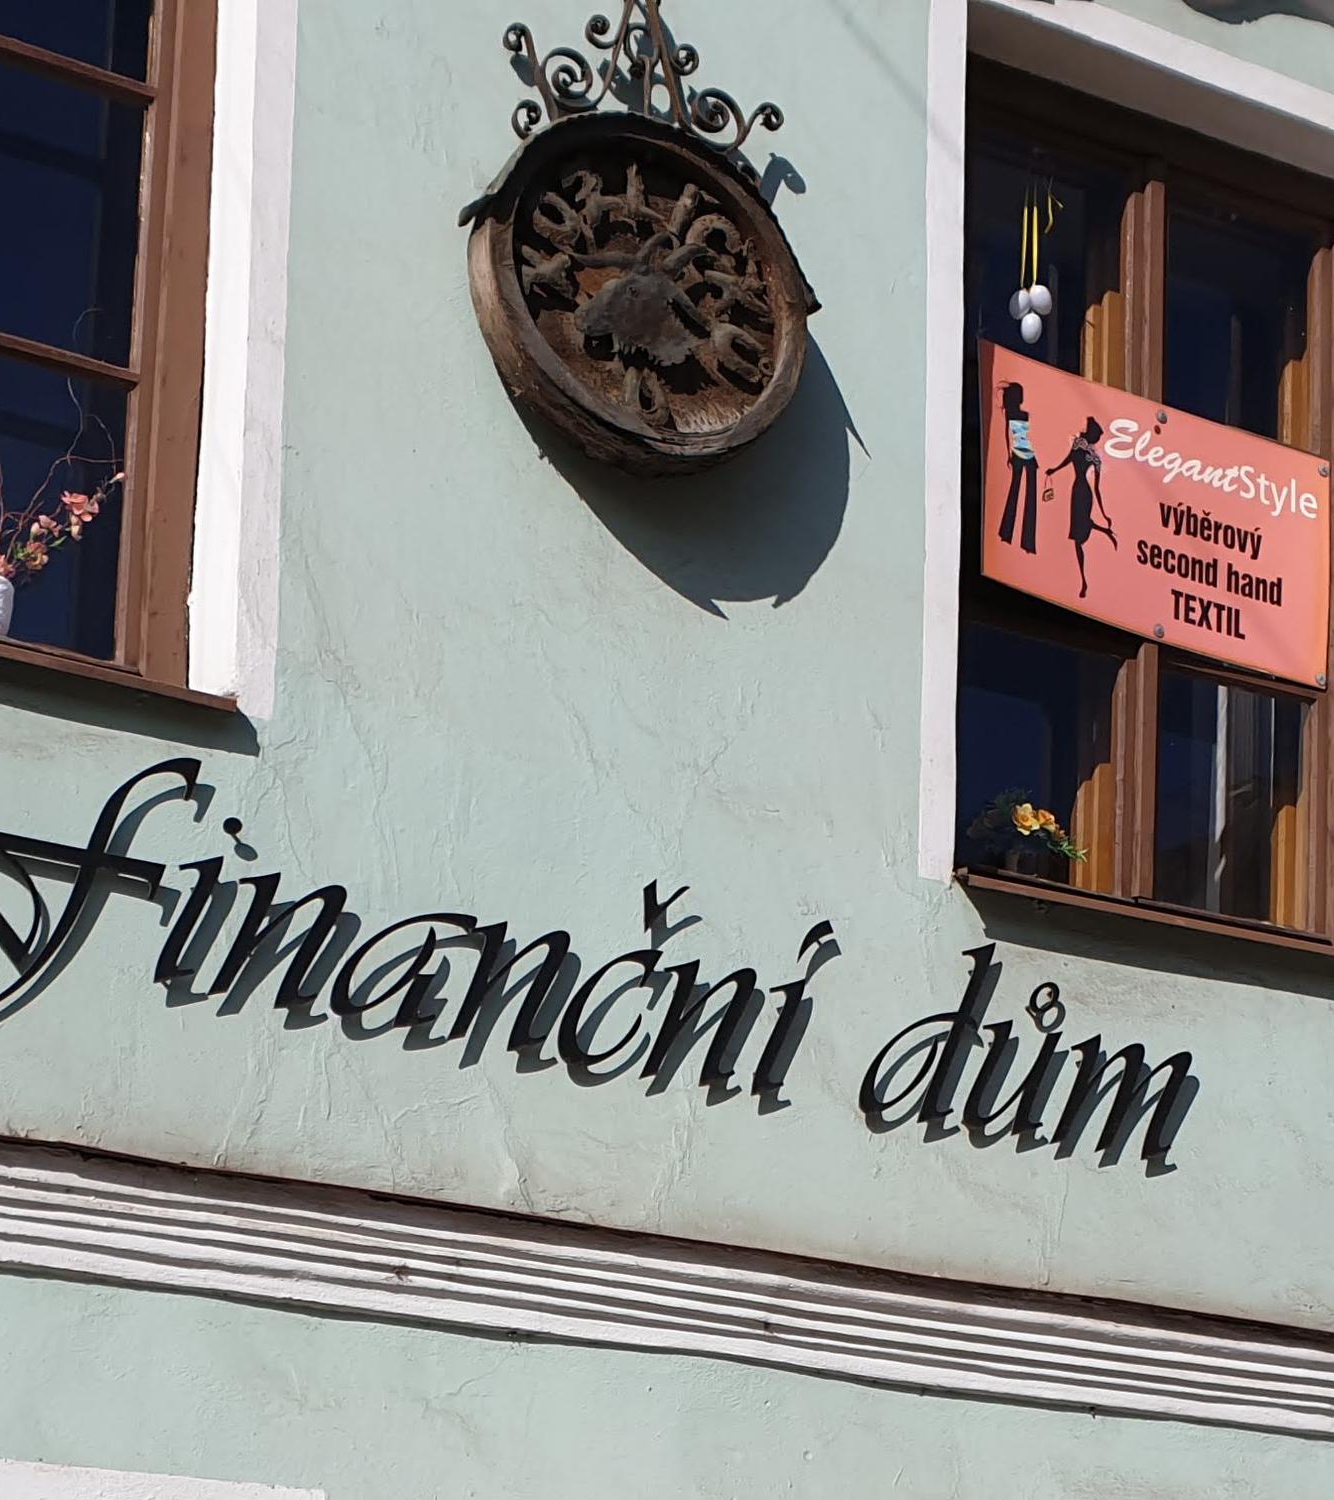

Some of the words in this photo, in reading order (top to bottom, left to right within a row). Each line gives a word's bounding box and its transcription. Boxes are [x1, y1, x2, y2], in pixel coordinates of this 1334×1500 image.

[1104, 418, 1319, 519] ElegantStyle
[1159, 502, 1262, 560] výběrový
[1137, 540, 1218, 588] second
[1227, 563, 1283, 607] hand
[1171, 589, 1246, 640] TEXTIL
[858, 942, 1193, 1162] dům
